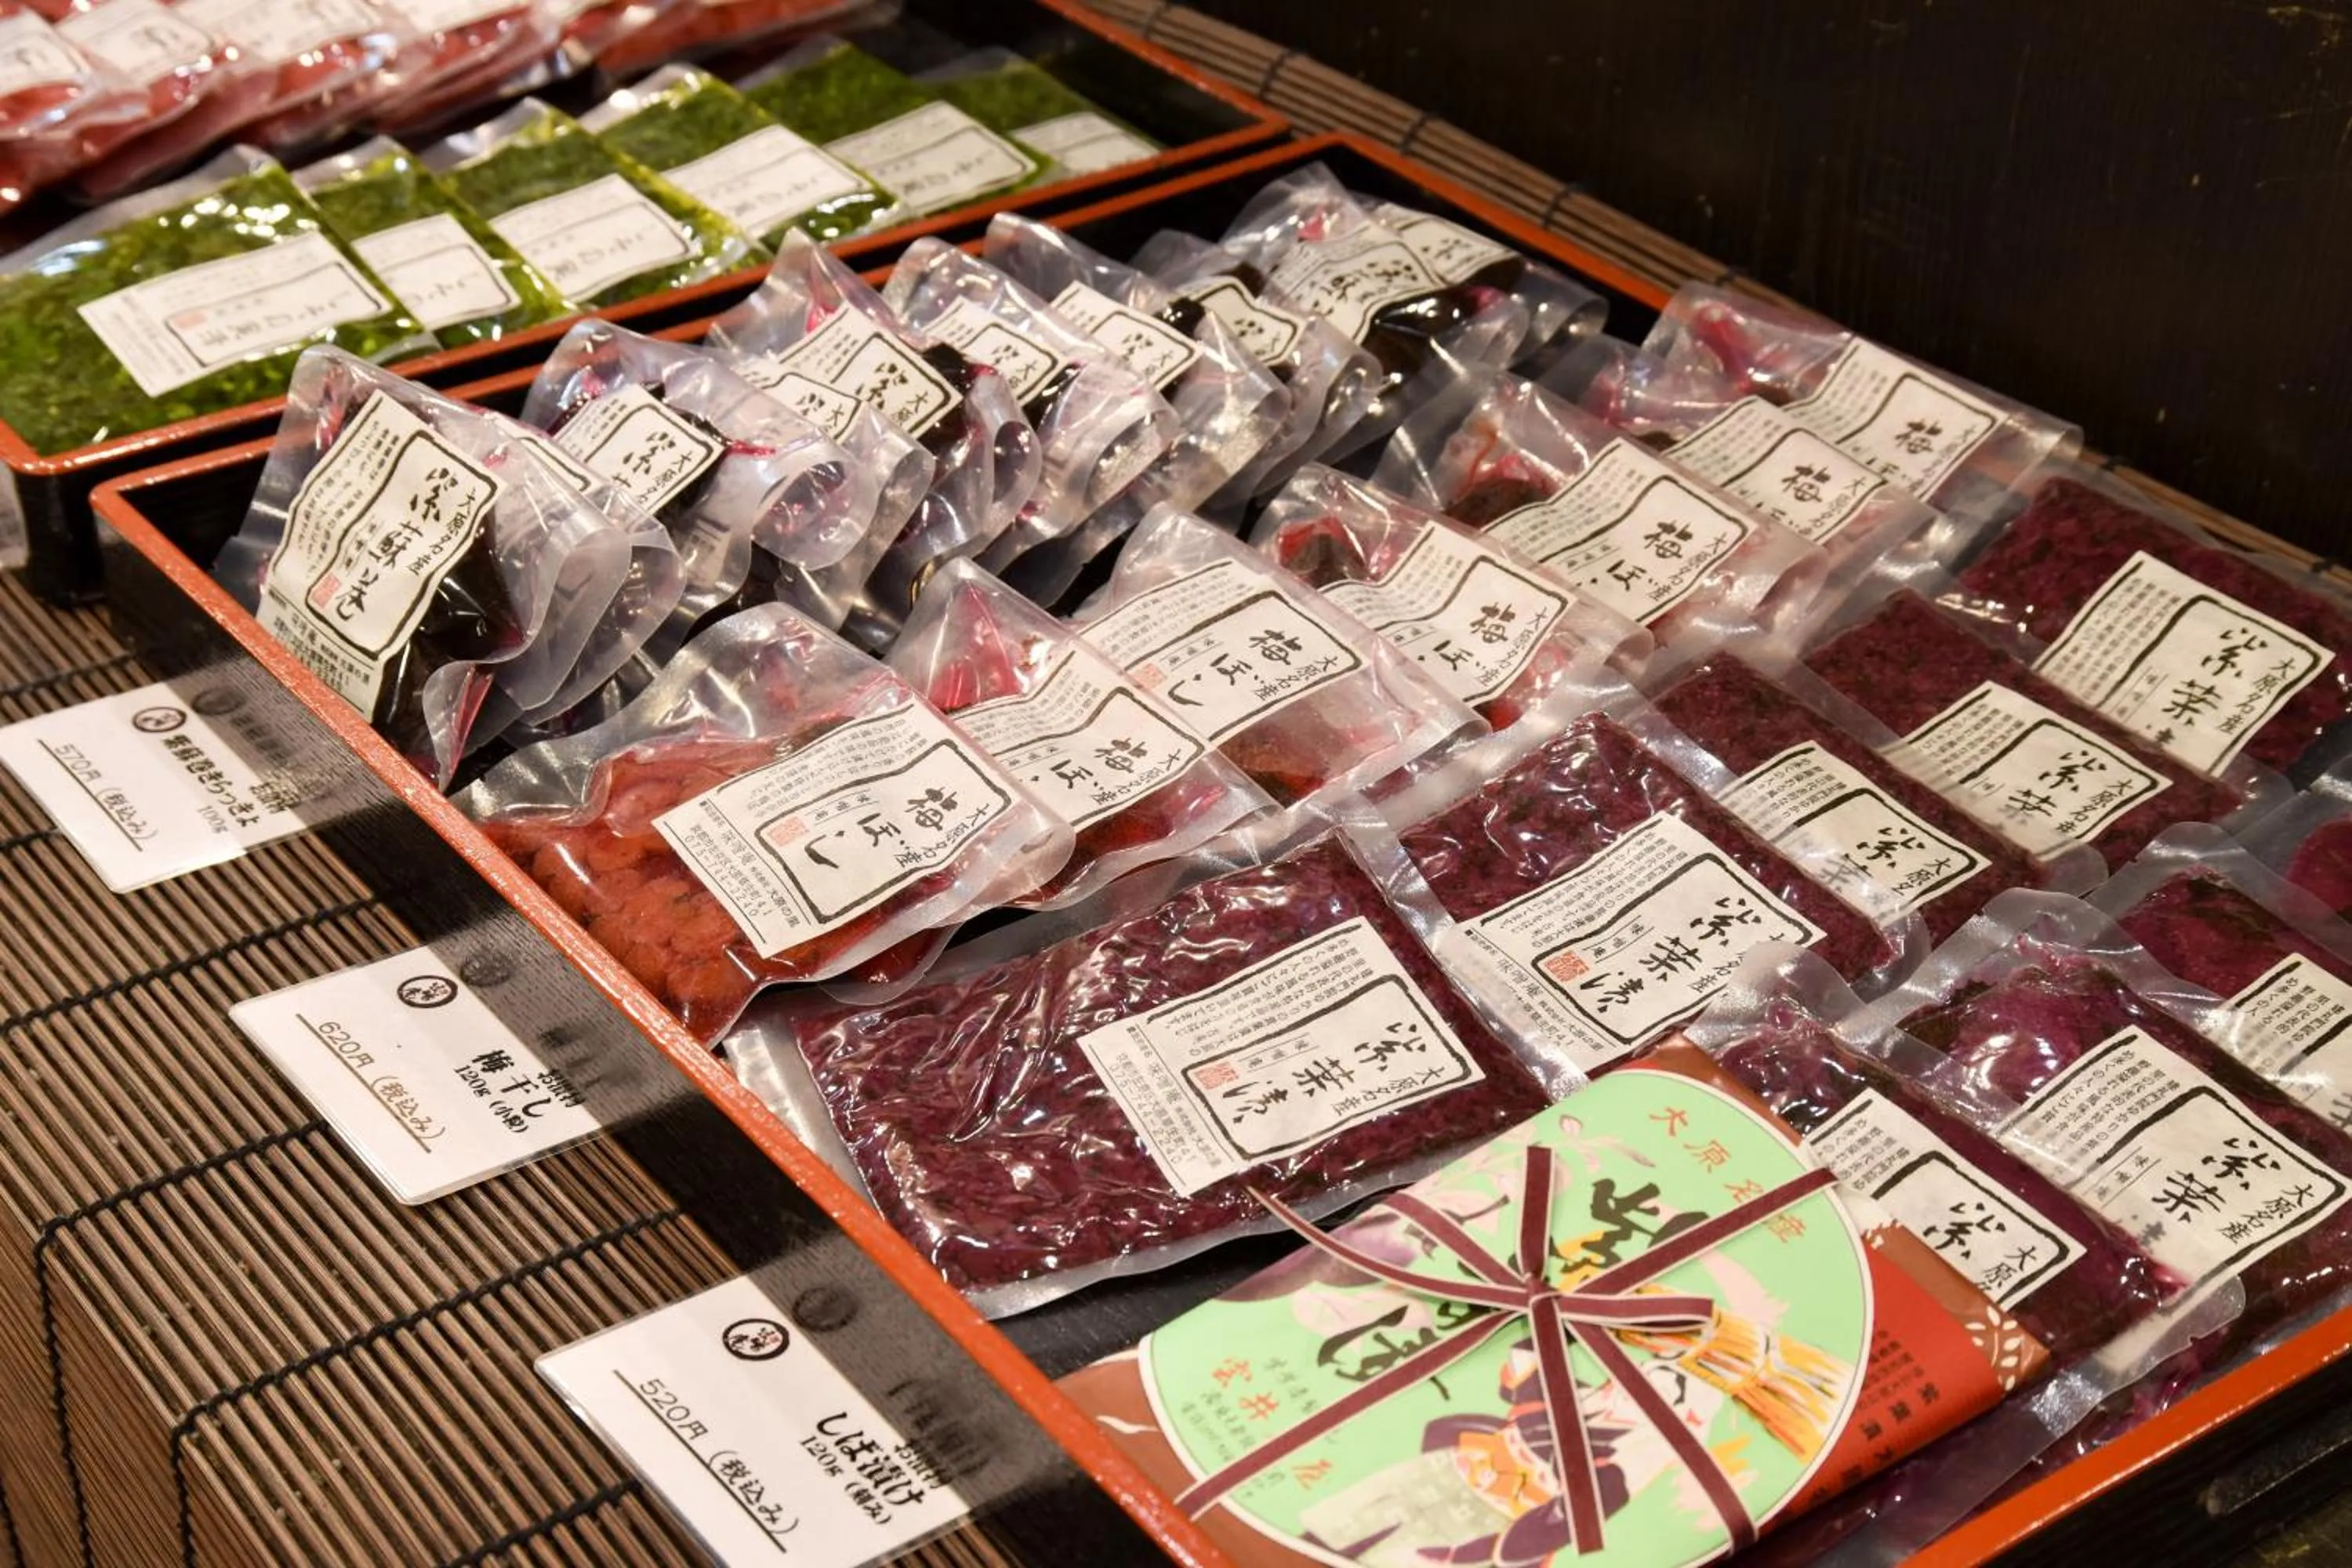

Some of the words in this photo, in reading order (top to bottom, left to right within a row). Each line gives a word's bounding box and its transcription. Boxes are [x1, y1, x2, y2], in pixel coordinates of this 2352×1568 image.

[408, 486, 481, 577] 大原名産
[1573, 518, 1697, 593] 梅ぼ
[1167, 628, 1305, 707] 梅ぼし
[1417, 601, 1516, 673] 梅ぼ
[1251, 654, 1341, 702] 大原名産
[2216, 656, 2298, 736] 大原名産
[54, 742, 103, 784] 570円
[1019, 737, 1149, 792] 梅ぼ
[1091, 749, 1182, 807] 大原名産
[196, 804, 230, 835] 100g
[803, 786, 960, 869] 梅ぼし
[892, 801, 993, 869] 大原名産
[2055, 778, 2134, 835] 大原名産
[317, 1020, 376, 1069] 620円
[470, 1047, 553, 1120] 梅干し
[1331, 1064, 1449, 1116] 大原名産
[2220, 1182, 2316, 1245] 大原名産
[637, 1377, 710, 1443] 520円
[815, 1410, 927, 1509] しば漬け
